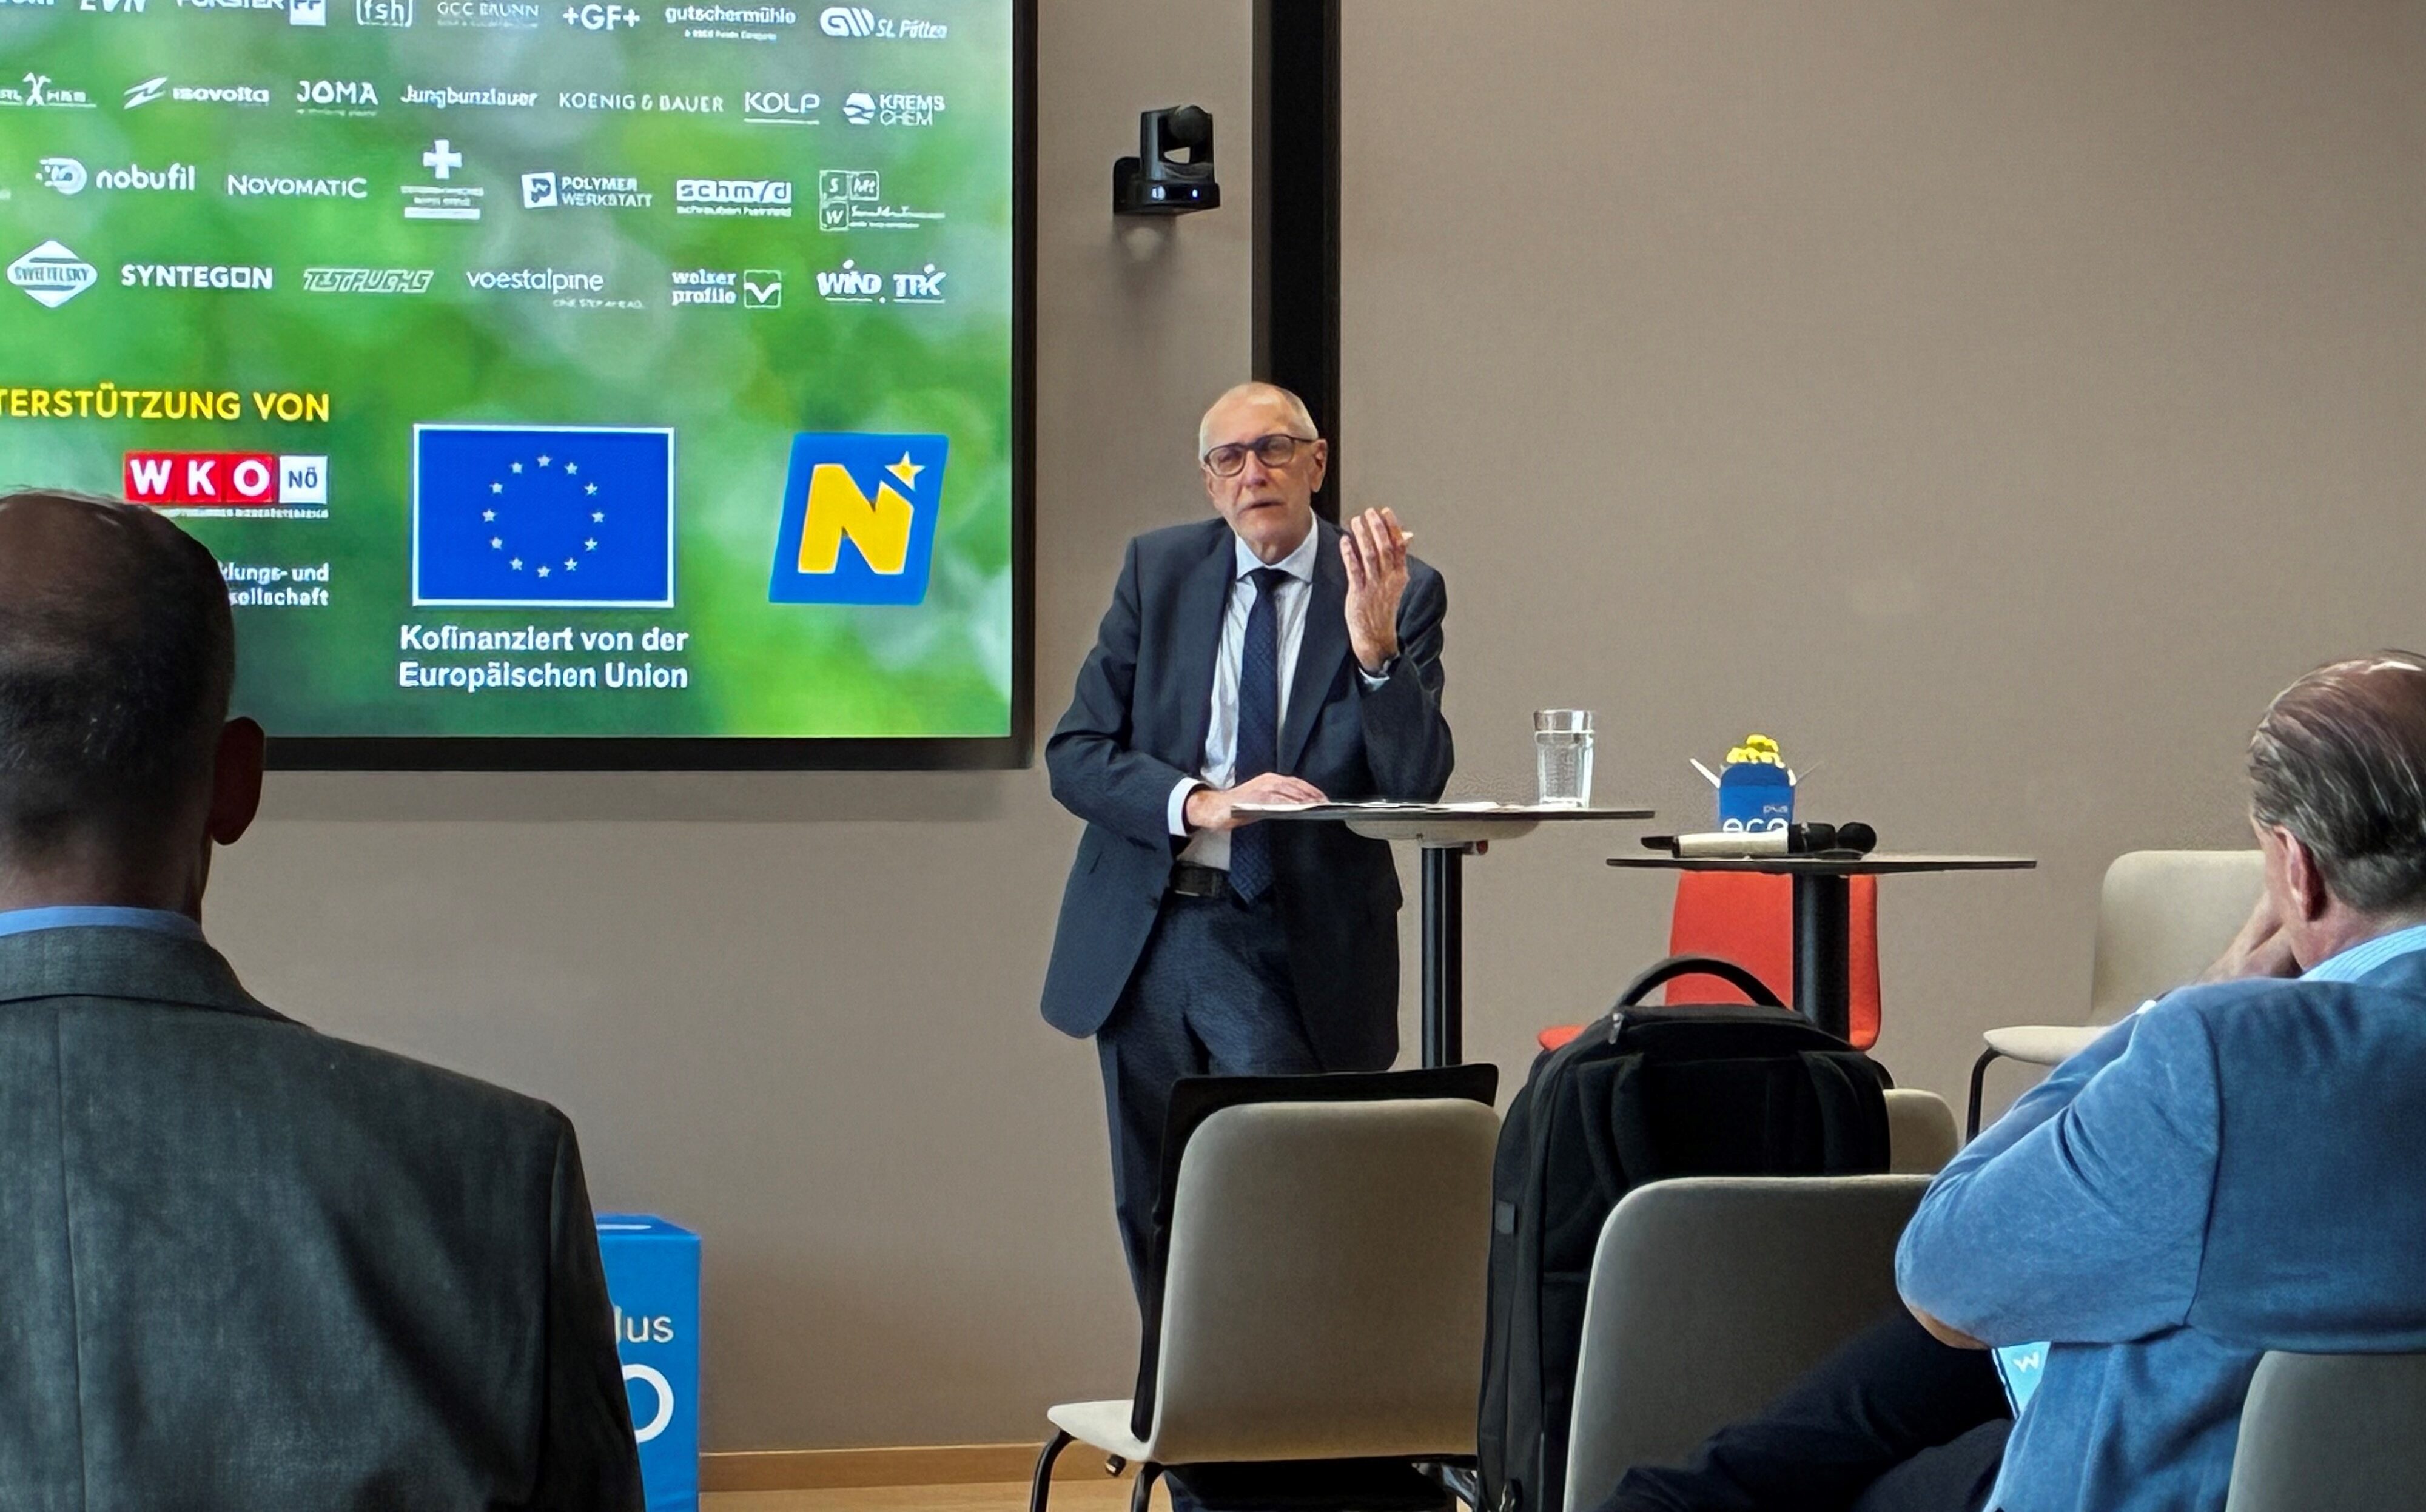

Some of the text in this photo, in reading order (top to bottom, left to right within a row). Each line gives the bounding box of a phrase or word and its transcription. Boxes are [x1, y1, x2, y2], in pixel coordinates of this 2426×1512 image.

[297, 81, 378, 105] JOMA
[400, 84, 538, 108] Jungbunzlauer
[559, 92, 724, 112] KOENIG & BAUER
[744, 91, 820, 113] KOLP
[879, 95, 945, 111] KREMS
[879, 110, 933, 126] CHEM
[96, 163, 195, 190] nobufil
[227, 175, 368, 198] NOVOMATIC
[562, 176, 637, 192] POLYMER
[121, 264, 273, 289] SYNTEGON
[466, 269, 604, 294] voestalpine
[253, 392, 329, 421] VON
[130, 460, 318, 496] WKO NÖ
[219, 562, 329, 585] klungs- und
[229, 587, 329, 606] sellschaft
[400, 625, 689, 651] Kofinanziert von der
[399, 661, 688, 693] Europäischen Union
[614, 1305, 674, 1343] lus
